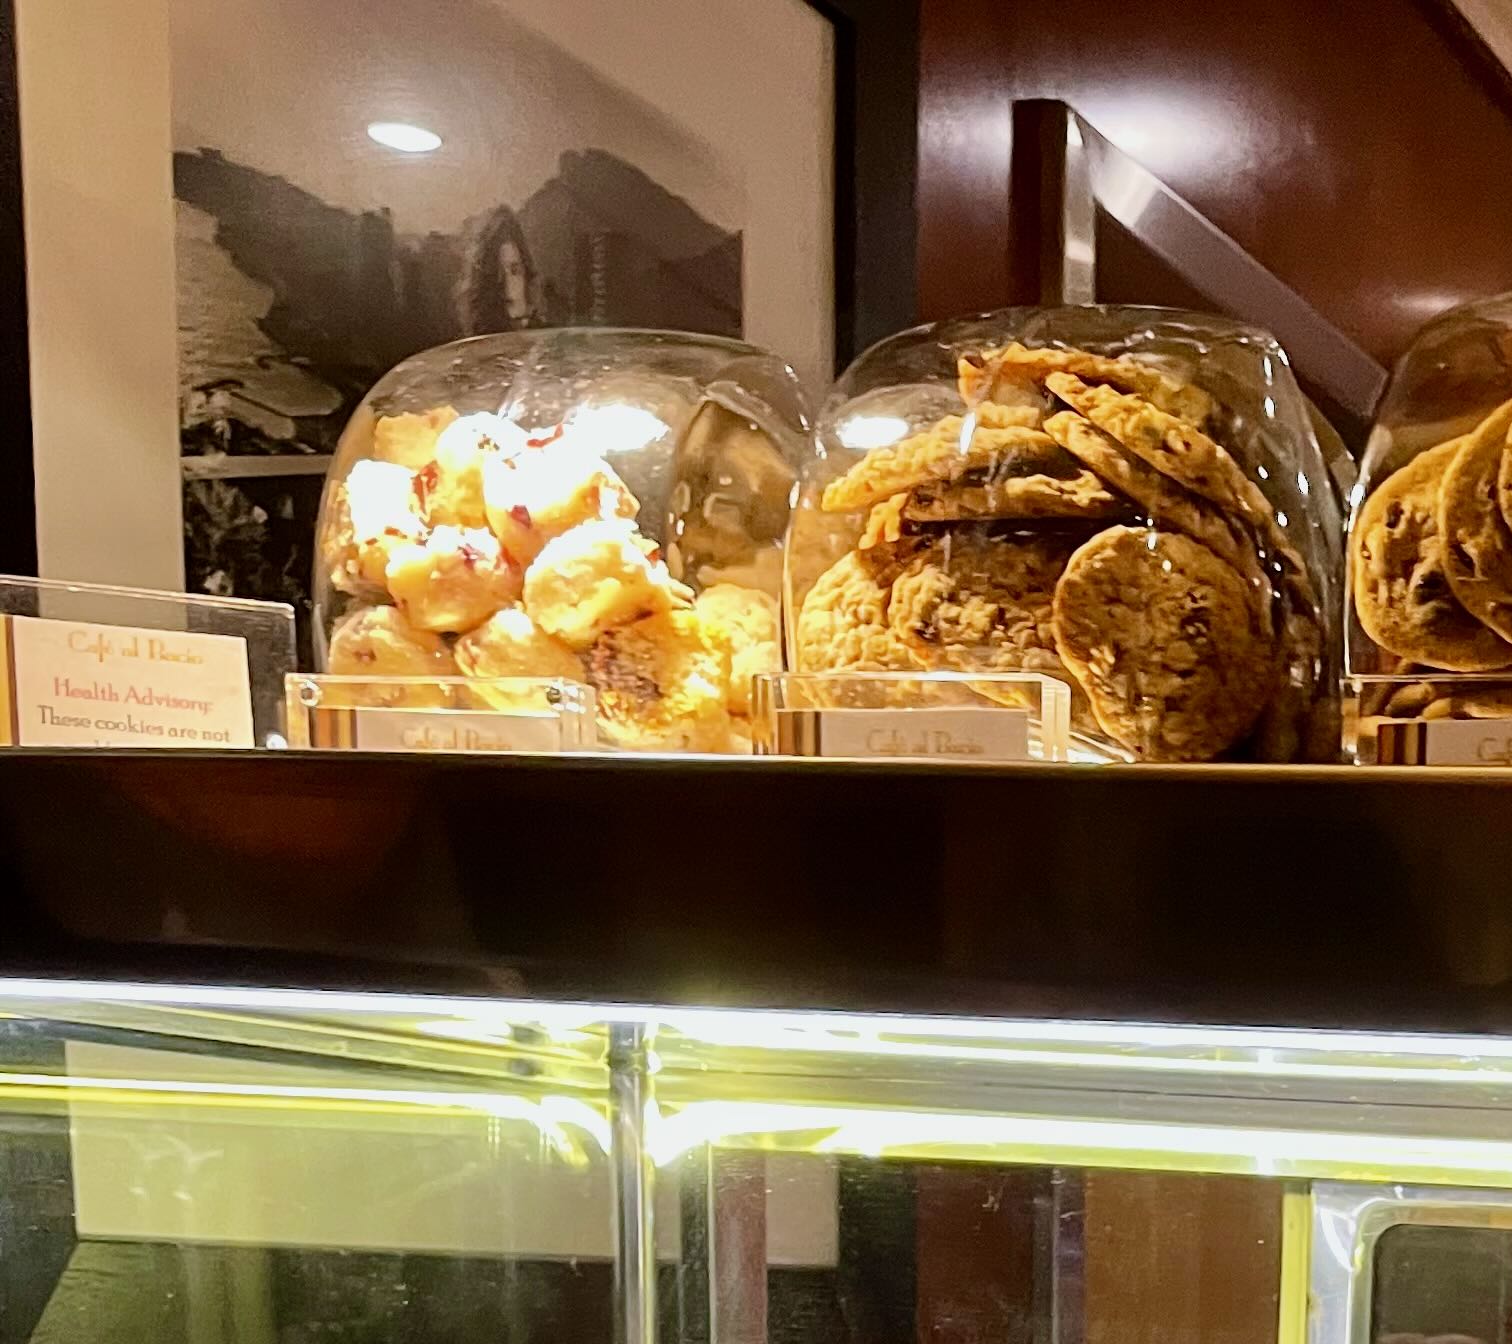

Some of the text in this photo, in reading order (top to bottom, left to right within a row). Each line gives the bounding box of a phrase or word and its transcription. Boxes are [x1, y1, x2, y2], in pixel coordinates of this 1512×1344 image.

[54, 676, 118, 702] Health
[37, 704, 231, 743] These cookies are not
